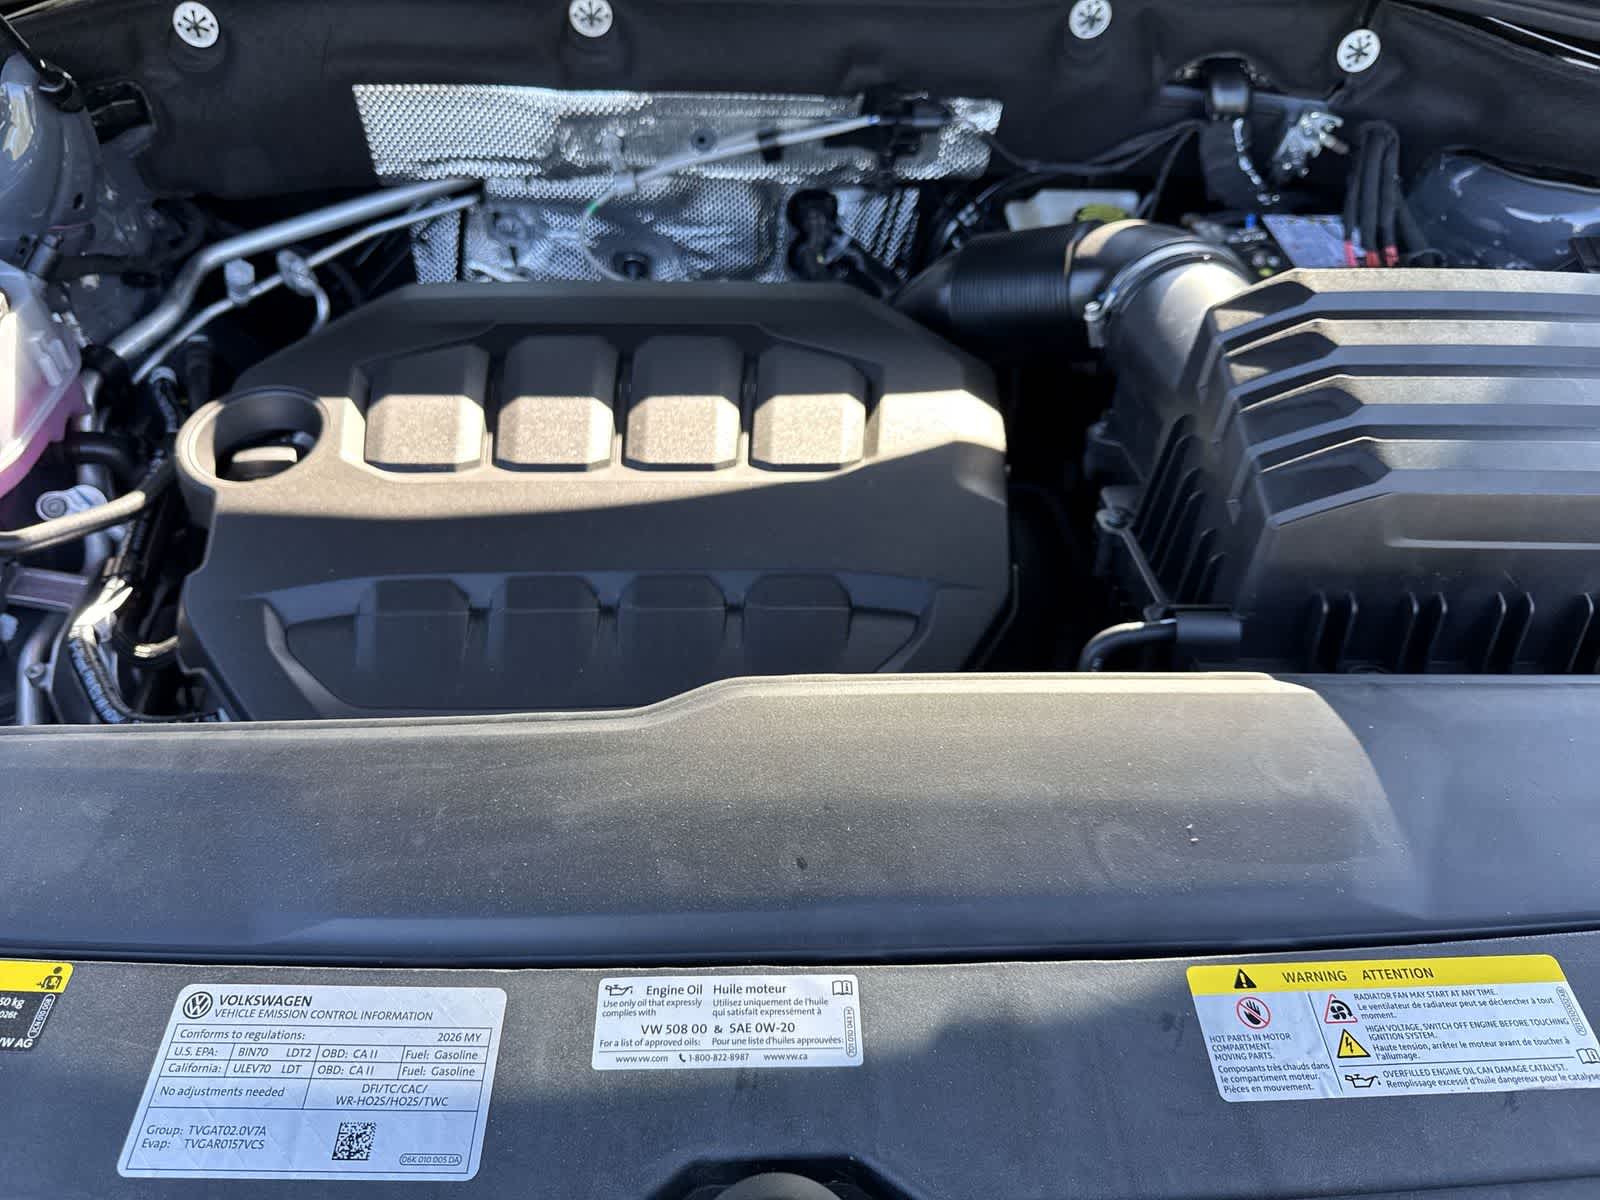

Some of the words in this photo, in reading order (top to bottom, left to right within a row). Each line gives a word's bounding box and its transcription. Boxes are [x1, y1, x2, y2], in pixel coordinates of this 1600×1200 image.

[1282, 970, 1347, 983] WARNING
[1362, 967, 1435, 981] ATTENTION
[646, 985, 685, 998] Engine
[687, 984, 703, 995] Oil
[713, 984, 743, 994] Huile
[746, 984, 787, 994] moteur
[1354, 991, 1392, 1001] RADIATOR
[1393, 991, 1409, 1000] FAN
[1410, 990, 1425, 999] MAY
[1426, 990, 1450, 998] START
[1451, 989, 1460, 997] AT
[1461, 989, 1476, 997] ANY
[1478, 988, 1498, 996] TIME.
[11, 996, 25, 1009] kg
[220, 995, 312, 1007] VOLKSWAGEN
[603, 1000, 618, 1008] Use
[619, 999, 637, 1009] only
[638, 998, 647, 1007] oil
[649, 998, 665, 1007] that
[666, 998, 703, 1008] expressly
[712, 998, 742, 1007] Utilisez
[743, 998, 792, 1009] uniquement
[793, 997, 803, 1006] de
[804, 997, 829, 1006] l'huile
[1357, 1003, 1367, 1011] Le
[1369, 1002, 1410, 1010] ventilateur
[1412, 1001, 1421, 1009] de
[1423, 1000, 1458, 1008] radiateur
[1459, 1000, 1477, 1009] peut
[1489, 997, 1529, 1006] déclencher
[1537, 997, 1554, 1005] tout
[215, 1009, 255, 1018] VEHICLE
[258, 1009, 308, 1019] EMISSION
[310, 1010, 358, 1020] CONTROL
[360, 1011, 433, 1021] INFORMATION
[601, 1009, 637, 1019] complies
[638, 1008, 657, 1017] with
[712, 1009, 726, 1018] qui
[726, 1007, 758, 1016] satisfait
[760, 1007, 815, 1017] expressément
[816, 1006, 822, 1015] à
[1361, 1012, 1397, 1020] moment.
[641, 1024, 663, 1035] VW
[665, 1023, 688, 1034] 508
[691, 1023, 708, 1034] 00
[713, 1025, 723, 1034] &
[729, 1023, 752, 1034] SAE
[755, 1022, 796, 1033] 0W-20
[1365, 1024, 1385, 1033] HIGH
[1423, 1021, 1452, 1031] SWITCH
[1453, 1021, 1468, 1030] OFF
[1469, 1020, 1500, 1029] ENGINE
[1500, 1019, 1530, 1028] BEFORE
[1530, 1017, 1570, 1026] TOUCHING
[180, 1029, 229, 1039] Conforms
[232, 1029, 242, 1039] to
[245, 1030, 305, 1041] regulations:
[437, 1032, 462, 1042] 2026
[464, 1032, 482, 1042] MY
[1209, 1034, 1227, 1043] HOT
[1228, 1033, 1252, 1042] PARTS
[1253, 1033, 1262, 1041] IN
[1263, 1032, 1291, 1041] MOTOR
[1369, 1032, 1404, 1041] IGNITION
[1406, 1031, 1438, 1040] SYSTEM.
[14, 1037, 33, 1048] AG
[599, 1039, 613, 1047] For
[620, 1039, 633, 1047] list
[634, 1038, 644, 1047] of
[644, 1038, 683, 1048] approved
[683, 1038, 701, 1046] oils:
[712, 1037, 730, 1046] Pour
[749, 1036, 764, 1045] liste
[765, 1036, 795, 1045] d'huiles
[1372, 1044, 1397, 1052] Haute
[1399, 1042, 1431, 1052] tension,
[1459, 1040, 1467, 1048] le
[1469, 1040, 1497, 1048] moteur
[1522, 1038, 1532, 1046] de
[1532, 1037, 1563, 1046] toucher
[1564, 1036, 1570, 1044] à
[174, 1047, 193, 1057] U.S.
[195, 1047, 218, 1057] EPA:
[238, 1047, 269, 1057] BIN70
[286, 1048, 312, 1058] LDT2
[1212, 1042, 1273, 1053] COMPARTMENT.
[321, 1049, 348, 1059] OBD:
[353, 1049, 368, 1059] CA
[405, 1050, 430, 1060] Fuel:
[434, 1050, 479, 1061] Gasoline
[615, 1055, 669, 1063] www.vw.com
[688, 1053, 750, 1062] 1-800-822-8987
[763, 1053, 808, 1062] www.vw.ca
[1214, 1052, 1247, 1061] MOVING
[1248, 1052, 1276, 1060] PARTS.
[168, 1063, 222, 1074] California:
[233, 1063, 272, 1074] ULEV70
[281, 1064, 302, 1074] LDT
[317, 1065, 344, 1075] OBD:
[349, 1065, 366, 1075] CA
[401, 1066, 426, 1077] Fuel:
[431, 1066, 475, 1077] Gasoline
[1218, 1064, 1266, 1075] Composants
[1283, 1061, 1310, 1071] chauds
[1311, 1061, 1330, 1070] dans
[1383, 1069, 1430, 1078] OVERFILLED
[1432, 1067, 1461, 1076] ENGINE
[1462, 1067, 1475, 1075] OIL
[1477, 1066, 1493, 1074] CAN
[1494, 1064, 1528, 1073] DAMAGE
[1529, 1063, 1568, 1072] CATALYST.
[1221, 1075, 1229, 1084] le
[1230, 1073, 1288, 1084] compartiment
[1289, 1073, 1320, 1081] moteur.
[1387, 1079, 1437, 1088] Remplissage
[1438, 1077, 1469, 1086] excessif
[1470, 1076, 1497, 1085] d'huile
[1497, 1075, 1538, 1084] dangereux
[1540, 1074, 1558, 1083] pour
[1558, 1073, 1566, 1081] le
[160, 1086, 176, 1096] No
[177, 1086, 243, 1099] adjustments
[245, 1087, 285, 1097] needed
[361, 1084, 429, 1094] DFI/TC/CAC/
[1223, 1084, 1250, 1094] Pièces
[1251, 1085, 1261, 1093] en
[1263, 1083, 1315, 1092] mouvement.
[335, 1096, 449, 1107] WR-HO2S/HO2S/TWC
[146, 1124, 184, 1137] Group:
[188, 1125, 267, 1137] TVGAT02.0V7A
[141, 1138, 171, 1151] Evap:
[184, 1138, 265, 1150] TVGAR0157VCS
